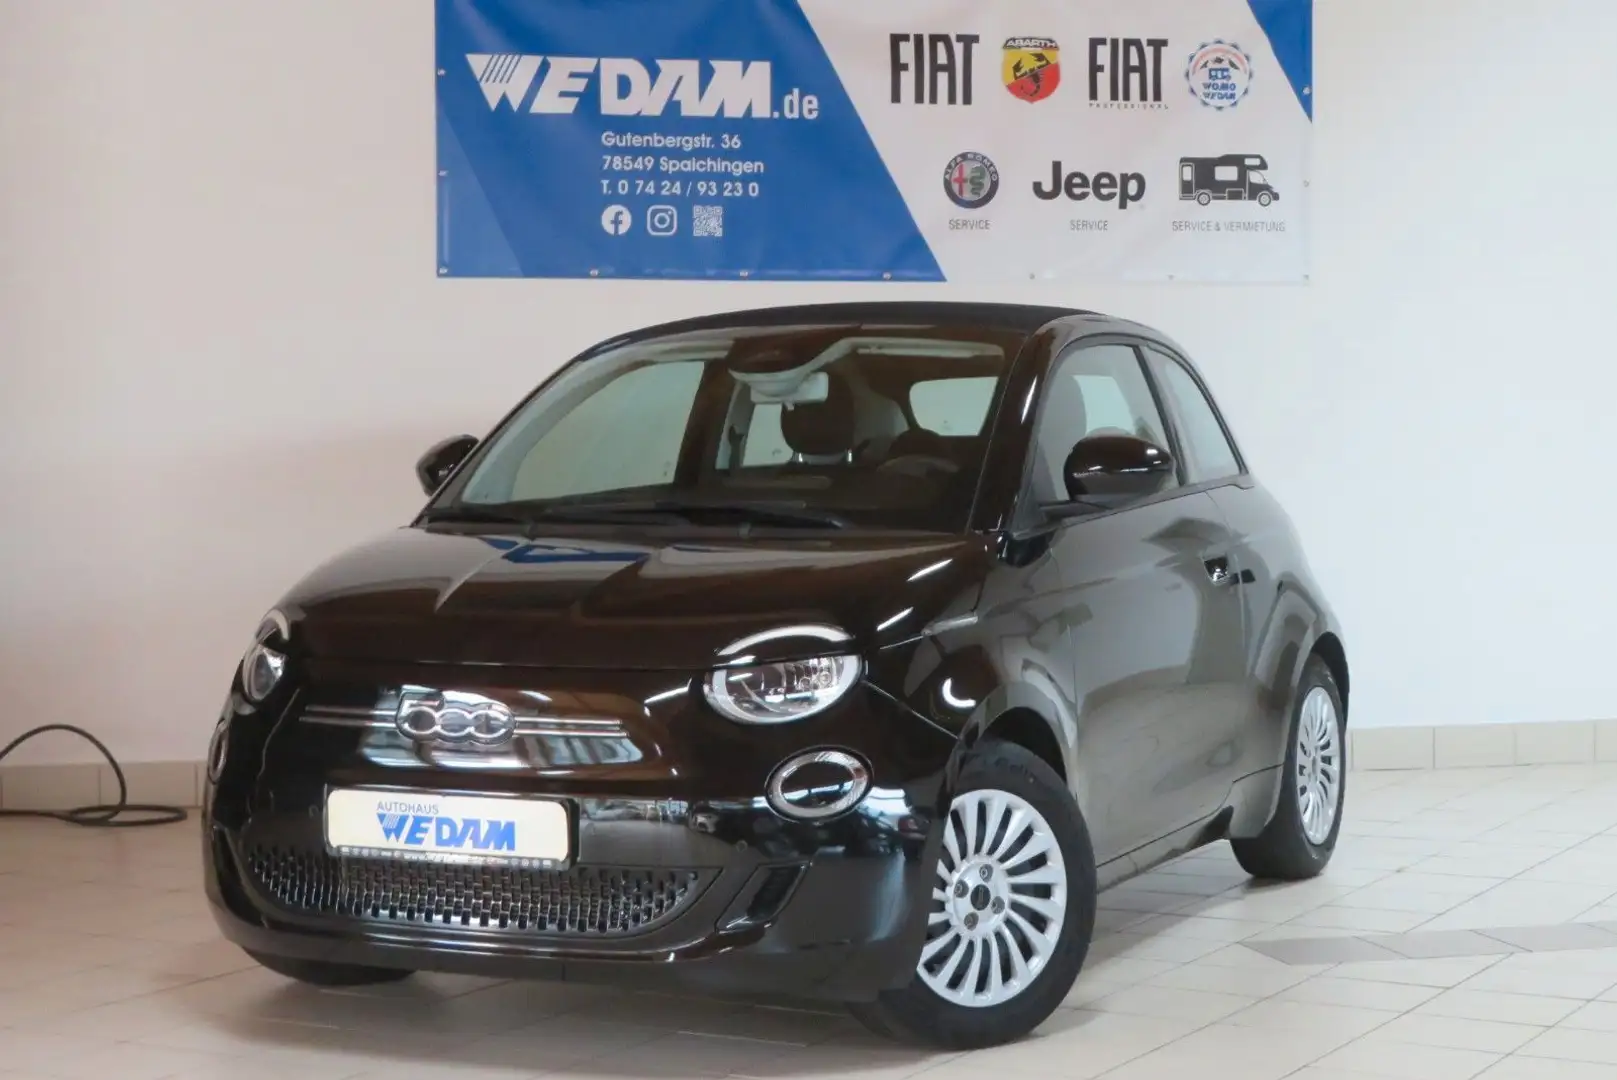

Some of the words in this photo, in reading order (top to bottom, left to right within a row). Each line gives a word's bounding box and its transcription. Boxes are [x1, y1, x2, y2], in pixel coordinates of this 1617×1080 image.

[1006, 38, 1056, 48] ABARTH
[889, 33, 980, 105] FIAT
[1088, 37, 1169, 103] FIAT
[601, 131, 715, 151] Gutenbergstr.
[720, 134, 741, 149] 36
[602, 155, 655, 171] 78549
[601, 180, 612, 195] T.
[618, 180, 629, 195] 0
[635, 180, 655, 195] 74
[660, 181, 682, 196] 24
[697, 181, 718, 196] 93
[722, 182, 743, 197] 23
[748, 182, 759, 197] 0
[1032, 160, 1146, 209] Jeep
[948, 219, 991, 231] SERVICE
[1070, 219, 1109, 231] SERVICE
[1171, 220, 1213, 232] SERVICE
[1214, 220, 1221, 232] &
[395, 685, 517, 745] 500
[376, 800, 439, 815] AUTOHAUS
[376, 812, 516, 851] WEDAM
